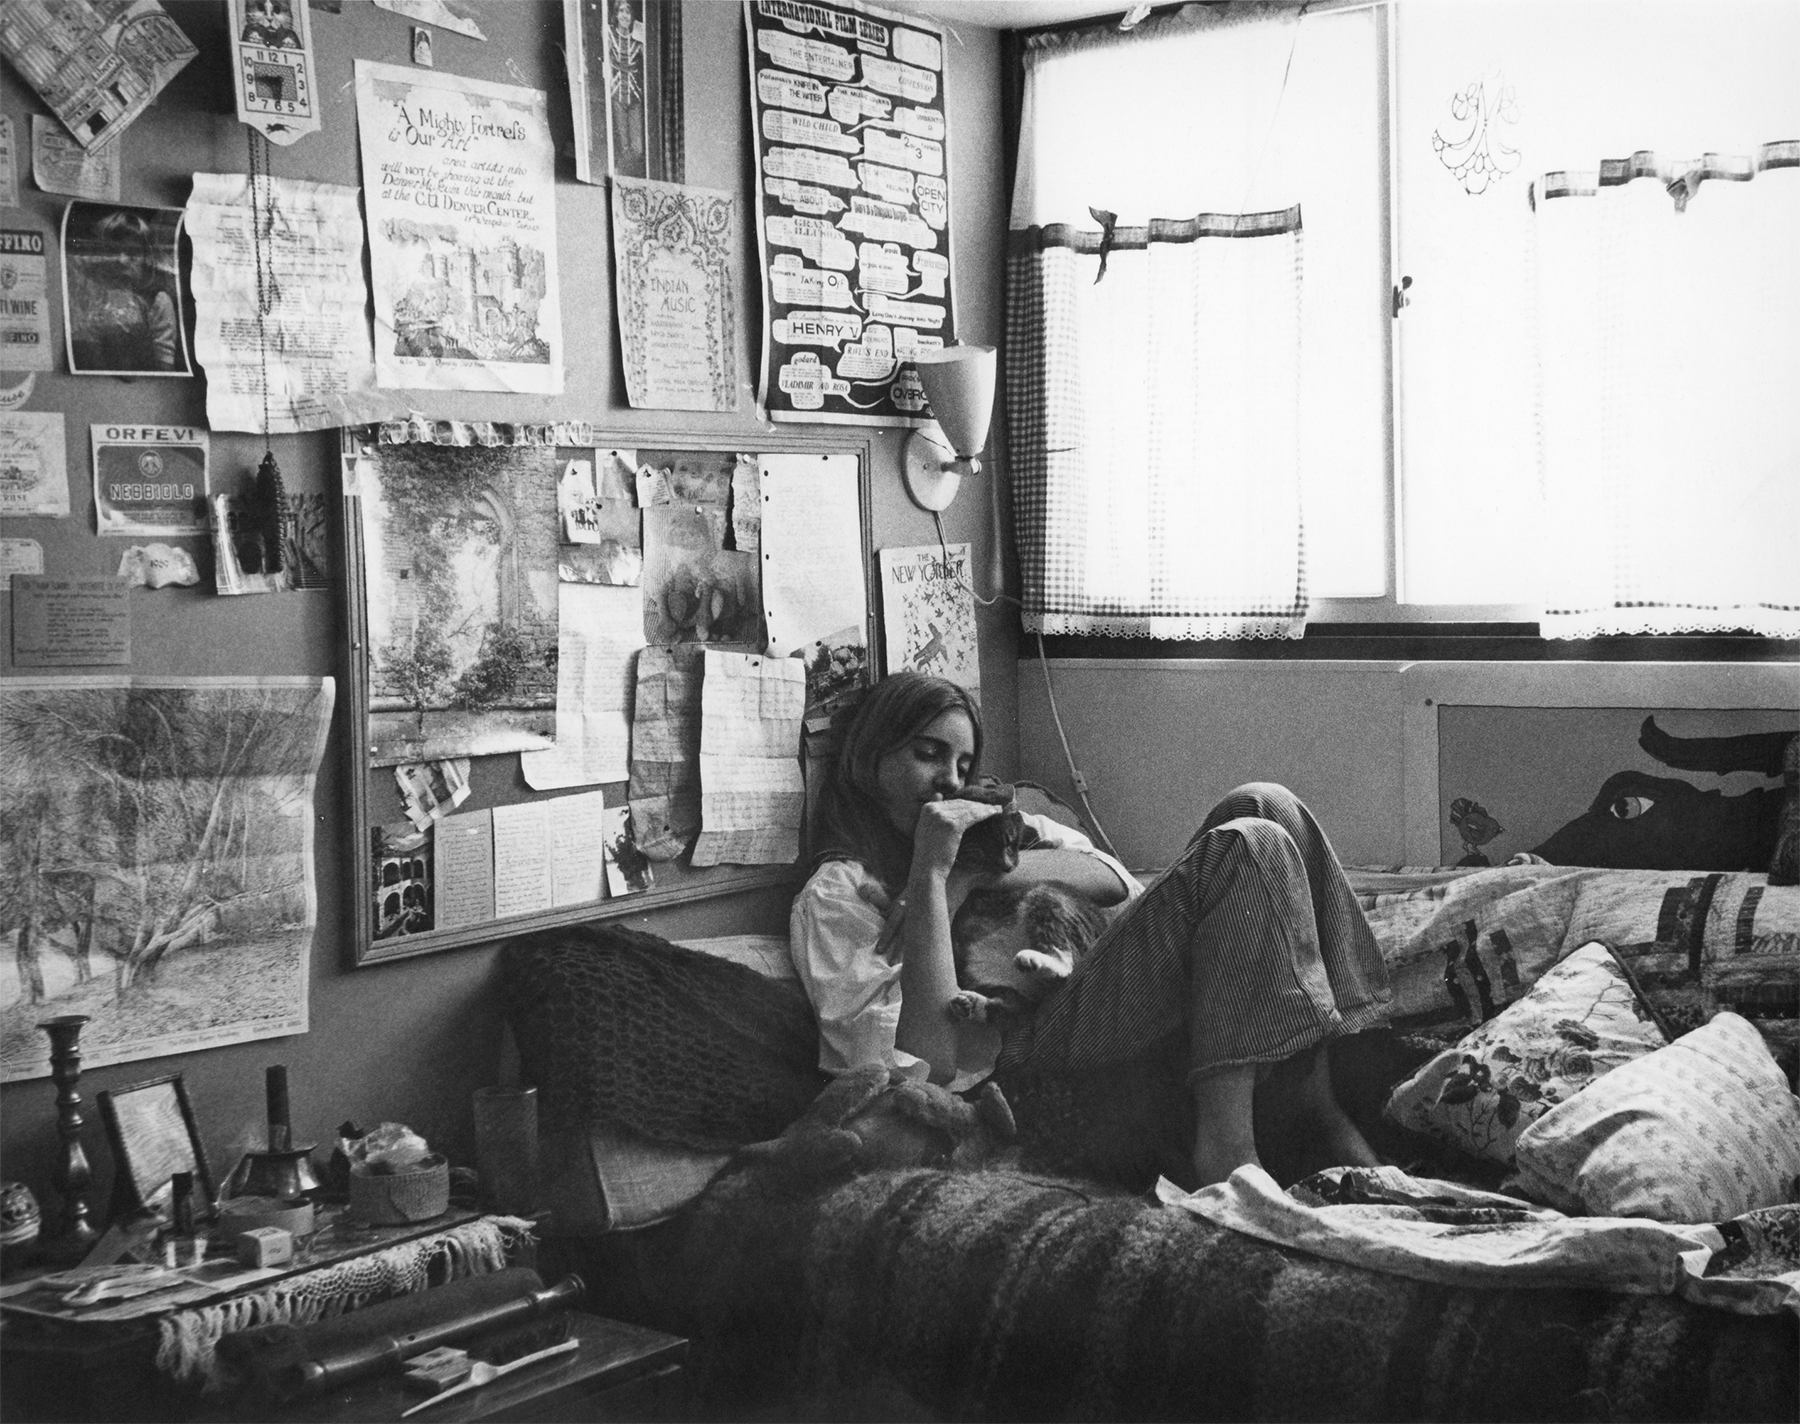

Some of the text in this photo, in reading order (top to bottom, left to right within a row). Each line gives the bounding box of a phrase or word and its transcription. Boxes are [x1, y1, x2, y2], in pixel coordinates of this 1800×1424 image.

[761, 0, 885, 43] INTERNATIONAL FILM SERIES
[244, 56, 303, 74] 10 2
[269, 52, 278, 63] 12
[789, 47, 853, 69] THE ENTERTAINER
[246, 73, 305, 90] 9 3
[248, 92, 307, 107] 8 4
[789, 87, 801, 98] THE
[261, 99, 268, 109] 7
[288, 102, 295, 112] 5
[419, 108, 466, 137] Mighty
[793, 117, 839, 132] WILD CHILD
[406, 125, 435, 145] Our
[904, 136, 910, 148] 2
[915, 148, 922, 159] 3
[380, 162, 403, 174] will
[404, 166, 426, 177] NOT
[427, 165, 439, 179] be
[442, 157, 466, 168] area
[394, 187, 411, 201] the
[443, 194, 488, 215] DENVER
[517, 191, 534, 204] but
[917, 186, 945, 202] OPEN
[921, 200, 944, 214] CITY
[650, 276, 689, 295] INDIAN
[11, 300, 38, 315] WINE
[660, 297, 696, 313] MUSIC
[793, 322, 844, 337] HENRY
[849, 326, 859, 338] V
[794, 354, 818, 365] godard
[875, 349, 889, 358] END
[782, 380, 814, 390] VLADIMIR
[110, 483, 195, 501] NEBBIOLO
[917, 553, 929, 563] THE
[892, 565, 916, 584] NEW
